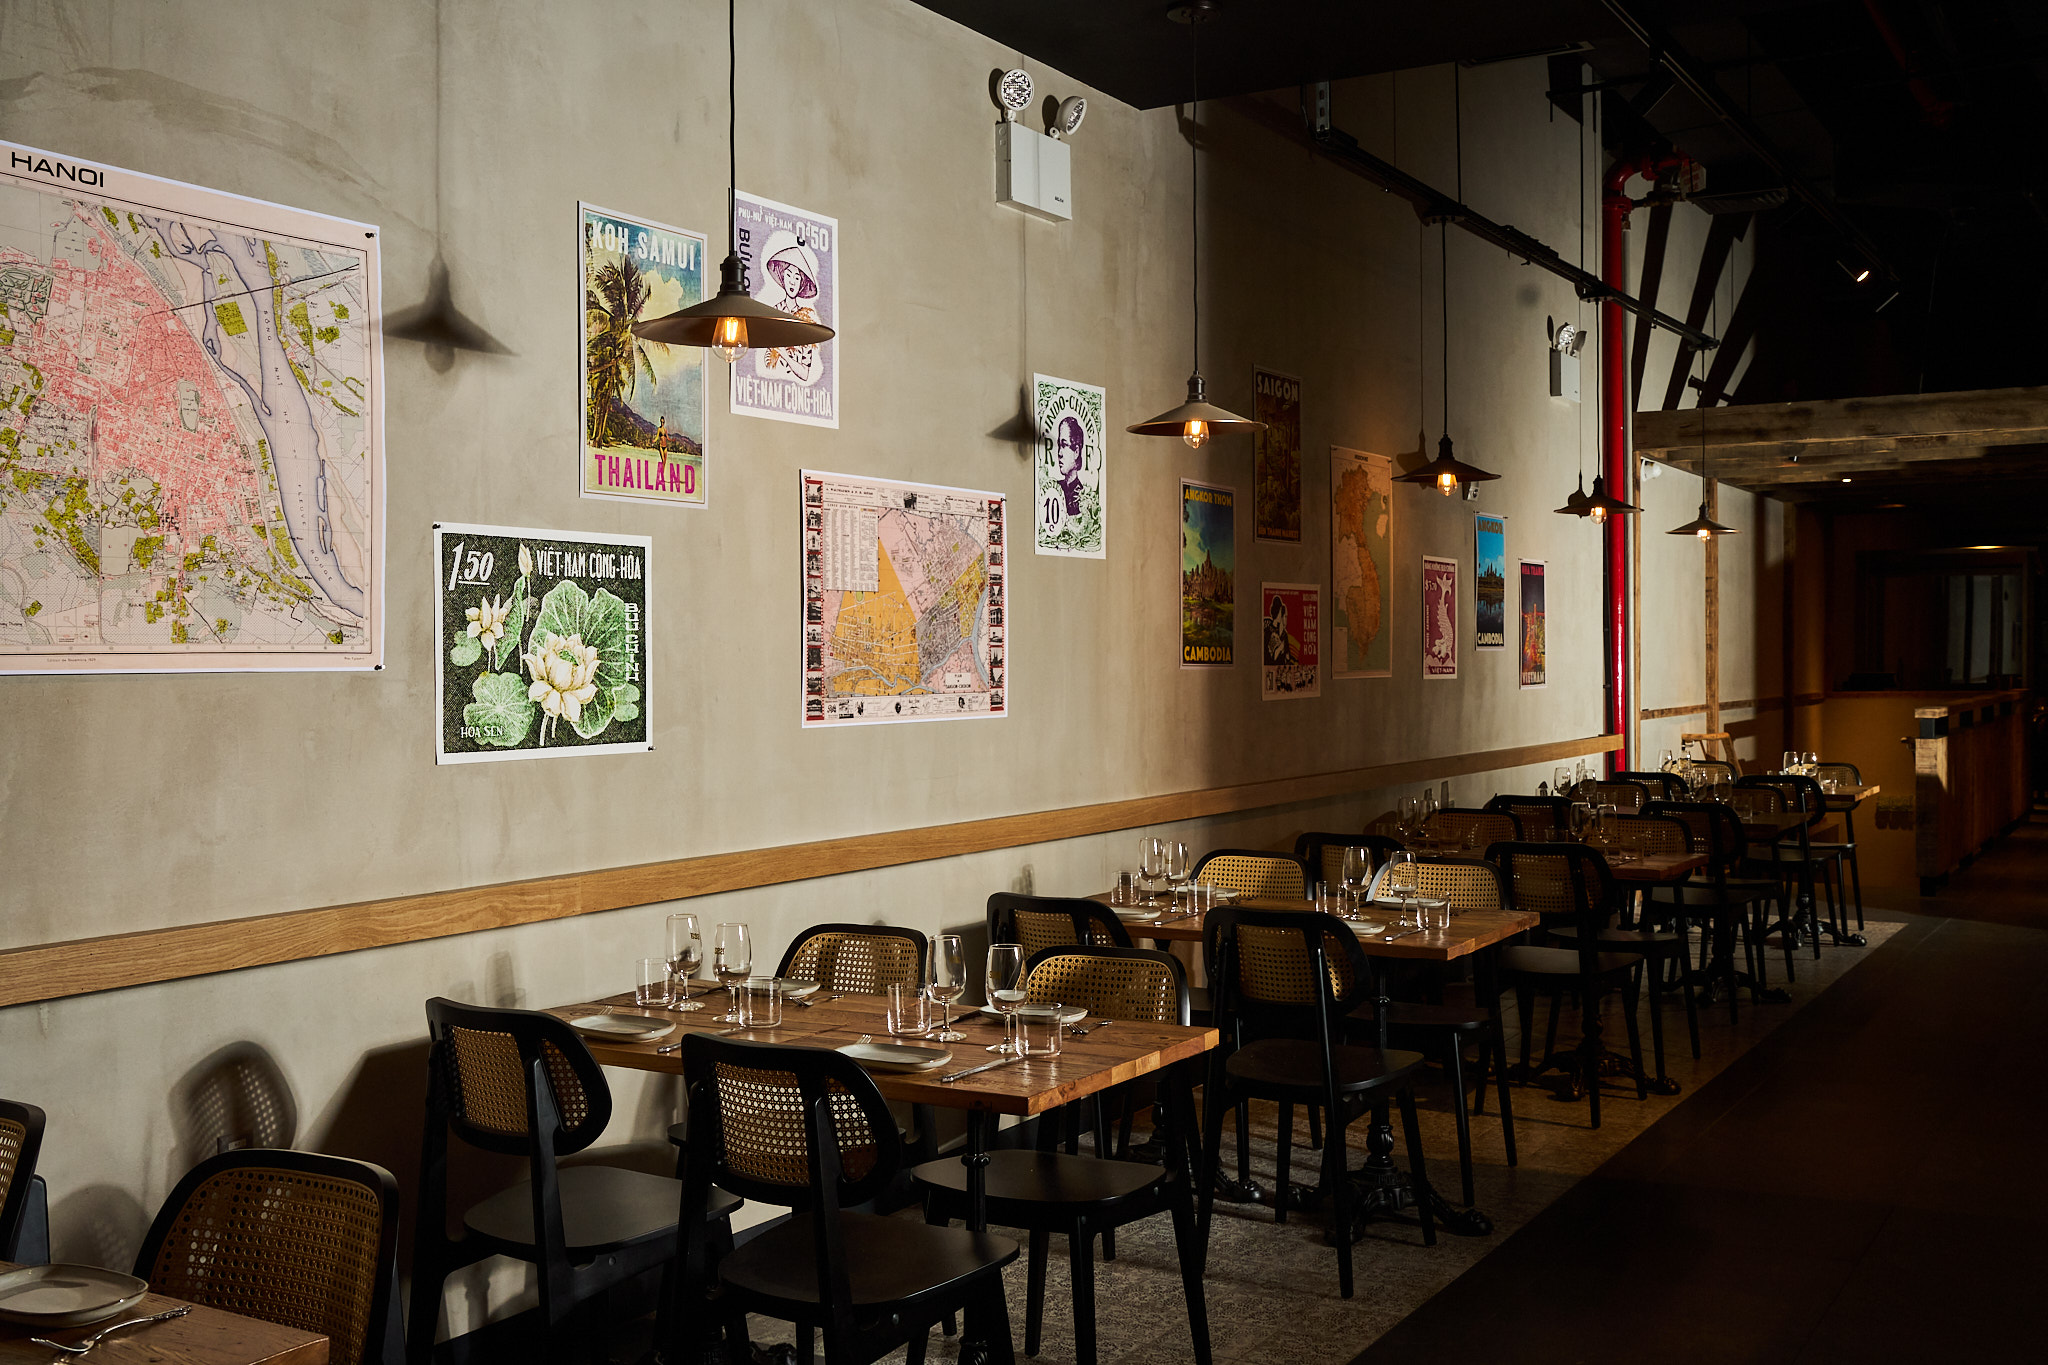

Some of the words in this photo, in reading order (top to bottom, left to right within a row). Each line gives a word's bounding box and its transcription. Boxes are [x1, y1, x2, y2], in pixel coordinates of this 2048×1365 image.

[11, 151, 104, 188] HANOI
[592, 219, 629, 255] KOH
[637, 231, 695, 271] SAMUI
[1044, 437, 1055, 467] R
[594, 454, 695, 494] THAILAND
[1184, 488, 1213, 504] ANGKOR
[1213, 493, 1232, 507] THOM
[1043, 497, 1060, 525] 10
[1477, 519, 1504, 535] ANGKOR
[1303, 618, 1316, 630] NAM
[1477, 632, 1504, 645] CAMBODIA
[1183, 645, 1232, 662] CAMBODIA
[460, 726, 482, 739] HOA
[483, 725, 504, 737] SEN
